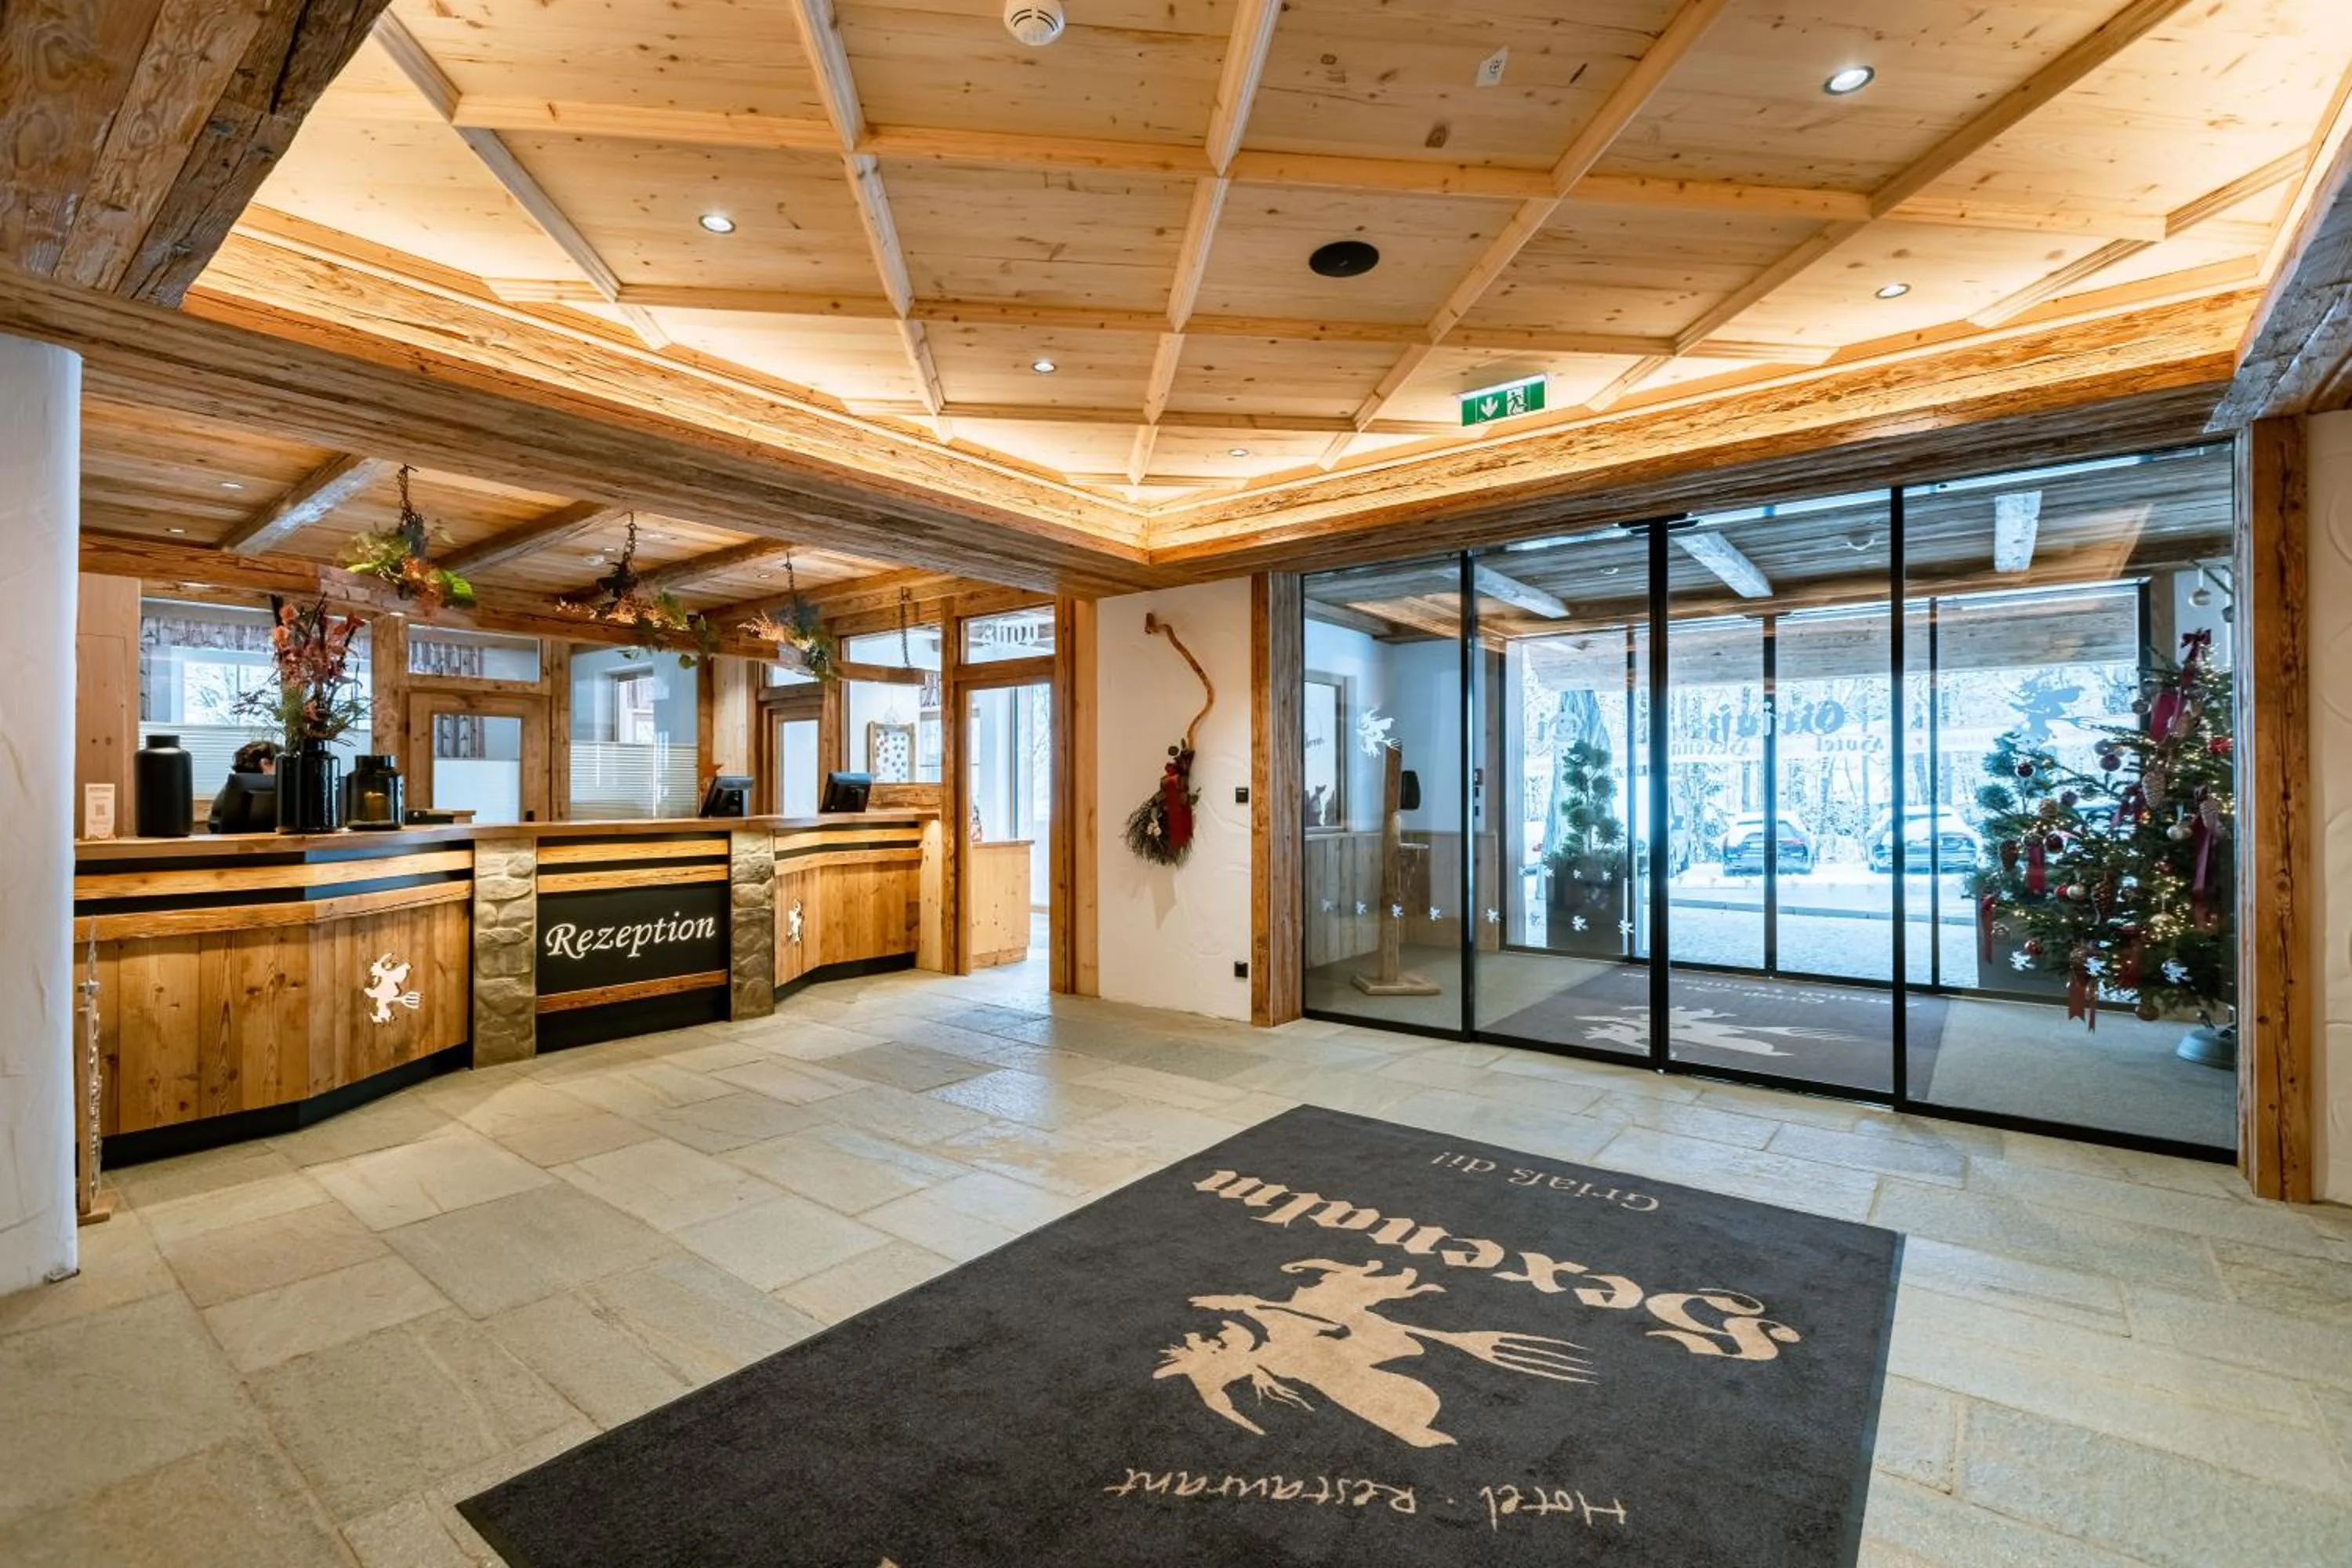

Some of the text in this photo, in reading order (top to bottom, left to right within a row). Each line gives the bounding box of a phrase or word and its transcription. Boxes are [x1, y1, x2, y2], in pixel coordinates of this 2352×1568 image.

[544, 910, 717, 960] Rezeption
[1504, 1167, 1660, 1212] Griaß
[1104, 1466, 1628, 1531] Hotel Restaurant
